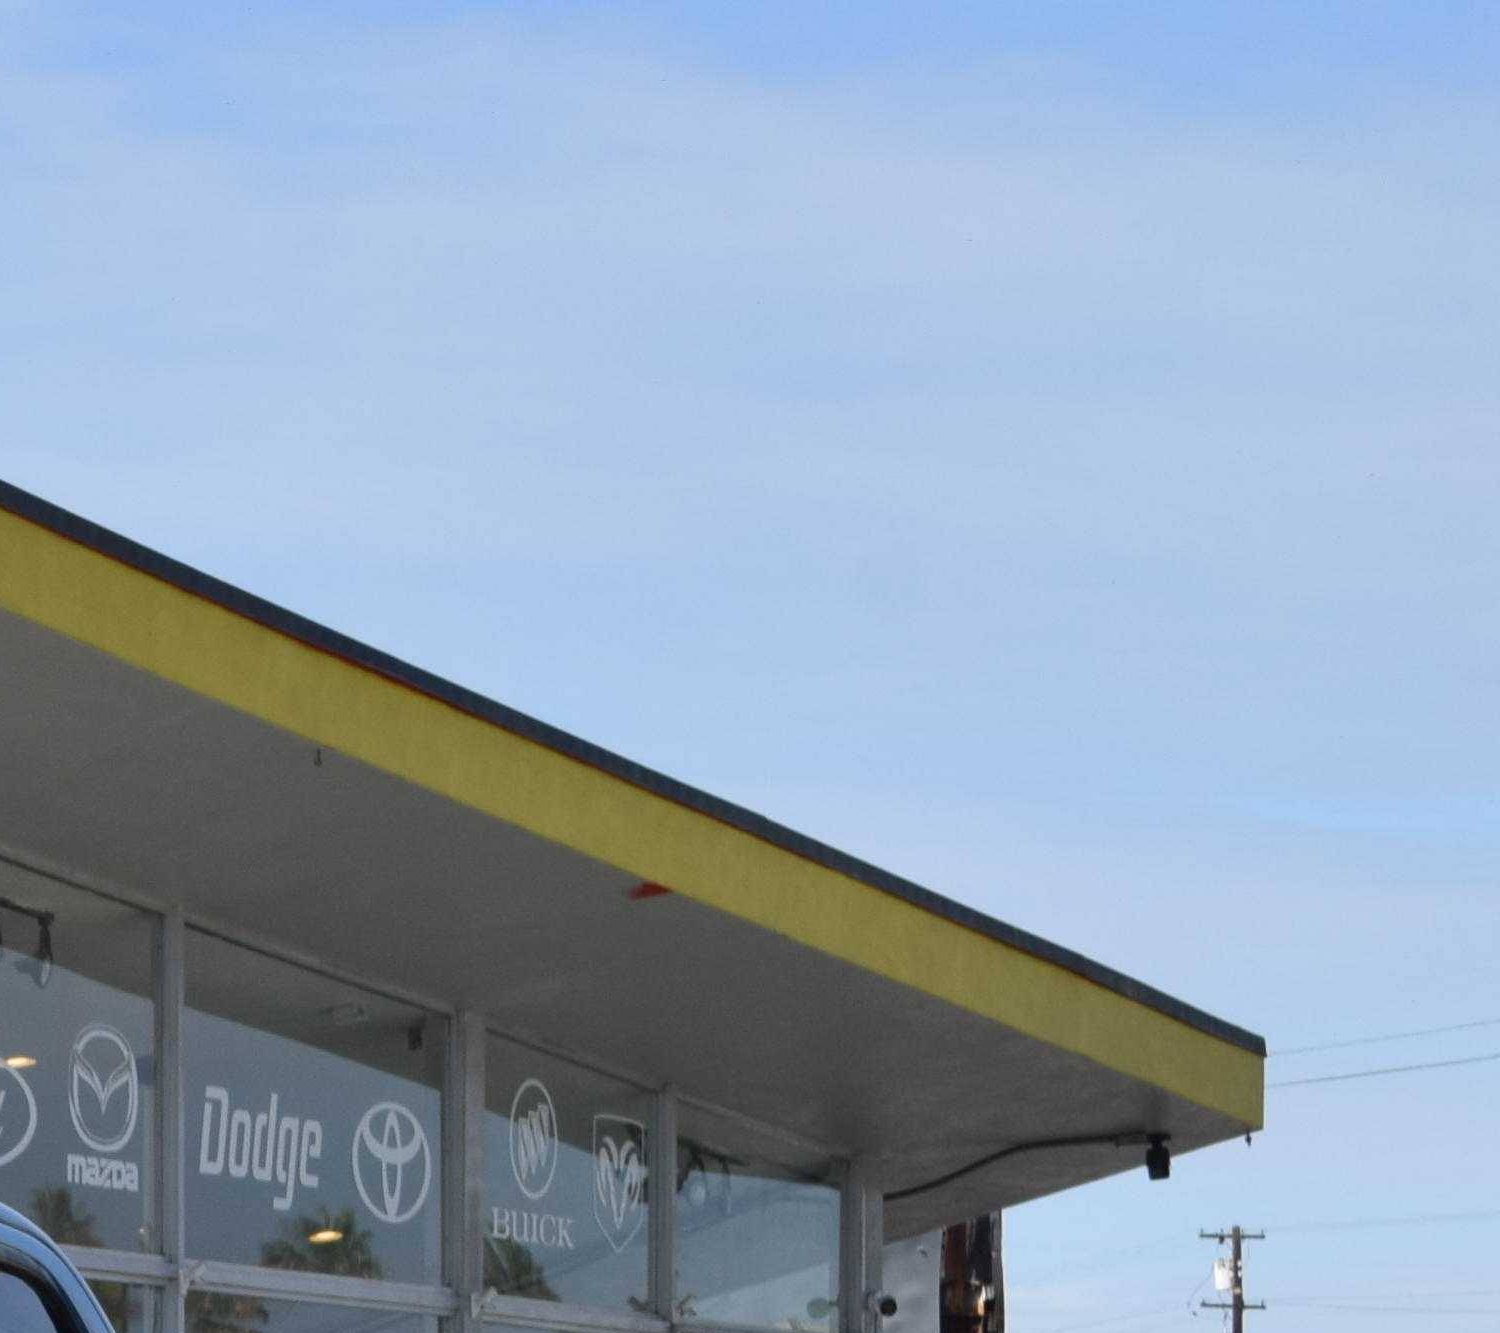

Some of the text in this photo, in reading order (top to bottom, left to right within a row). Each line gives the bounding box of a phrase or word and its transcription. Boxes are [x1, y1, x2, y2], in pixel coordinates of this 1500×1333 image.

[198, 1085, 324, 1211] Dodge
[66, 1153, 140, 1192] mazda
[491, 1206, 576, 1250] BUICK
